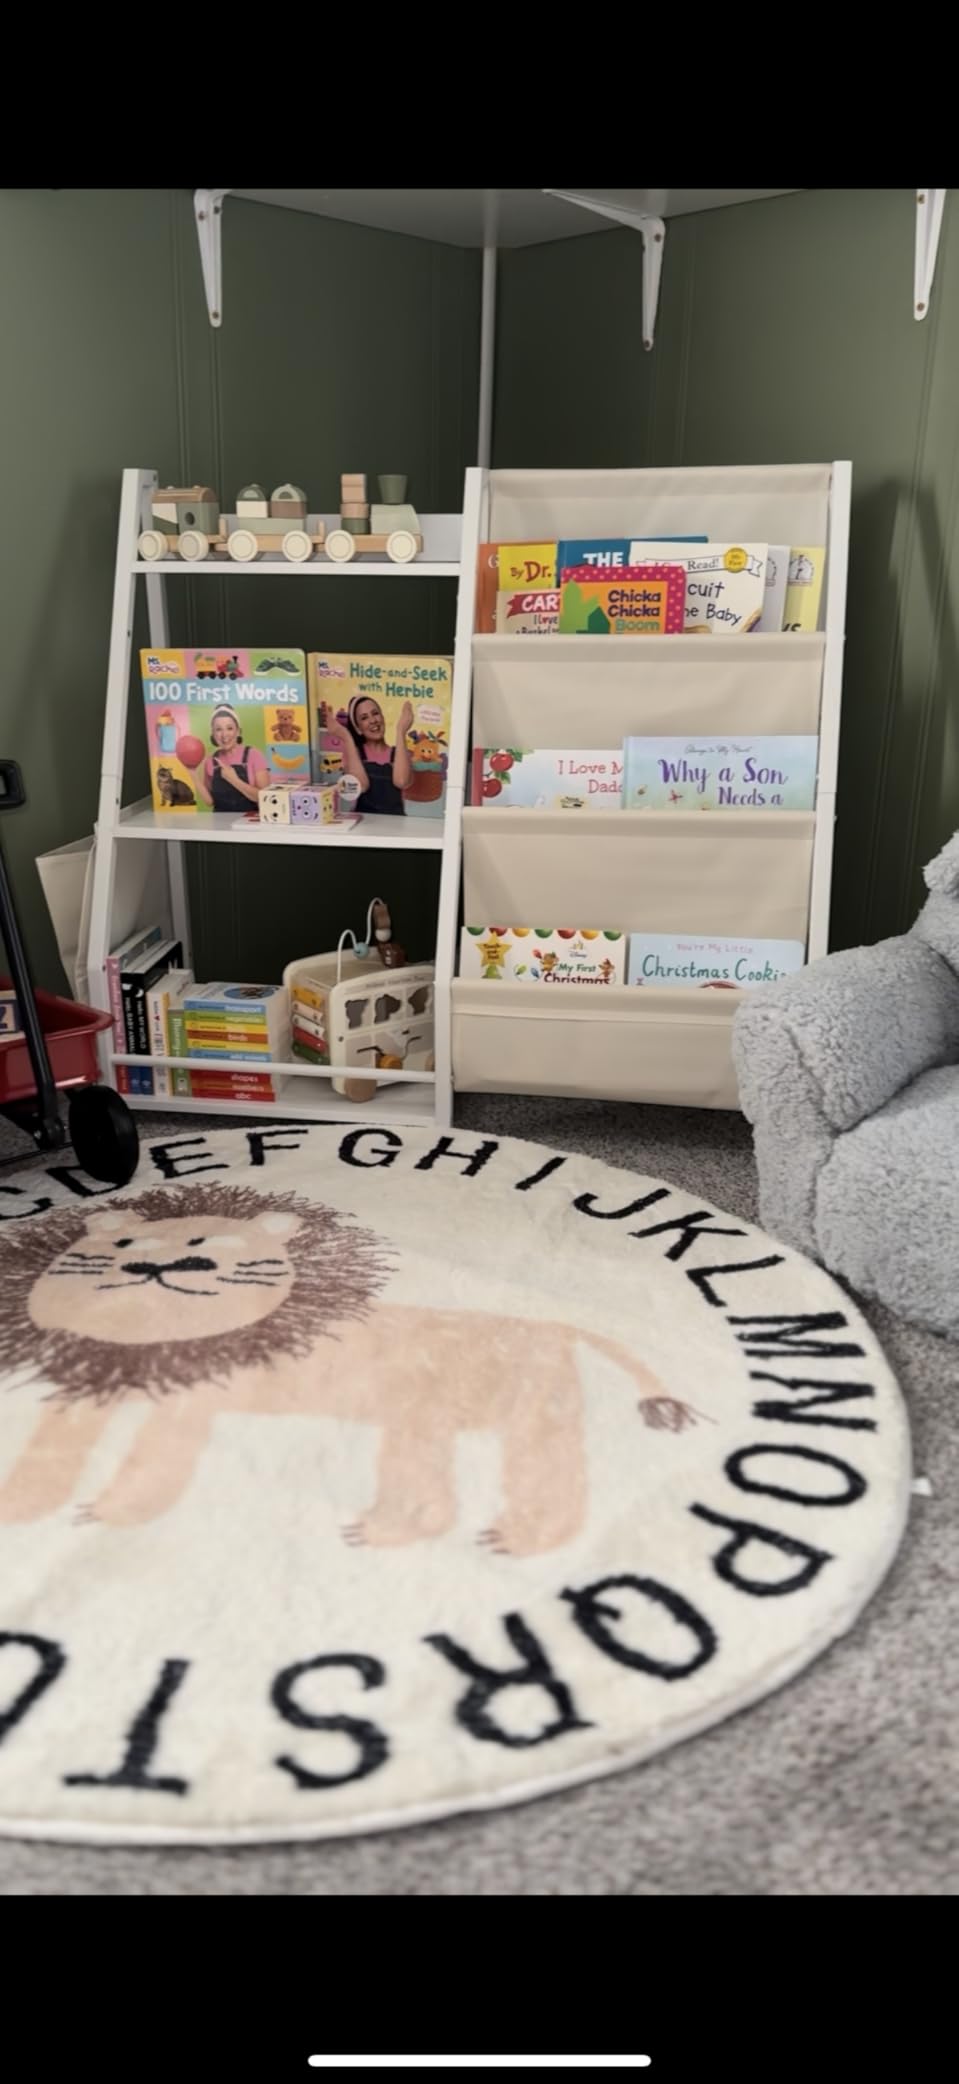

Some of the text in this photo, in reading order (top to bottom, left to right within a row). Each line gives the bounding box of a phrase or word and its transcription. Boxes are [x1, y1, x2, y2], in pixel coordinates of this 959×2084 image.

[510, 561, 552, 583] By Dr.
[582, 552, 624, 567] THE
[607, 604, 660, 617] Chicka
[608, 589, 661, 603] Chicka
[615, 619, 659, 631] Boom
[706, 603, 742, 626] Baby
[350, 662, 448, 681] Hide-and-Seek
[149, 682, 299, 702] 100 First Words
[359, 682, 434, 698] with Herbie
[558, 760, 564, 775] I
[569, 760, 606, 774] Love
[657, 757, 789, 794] Why a Son
[718, 786, 784, 806] Needs a
[708, 944, 721, 953] My
[558, 963, 596, 975] My First
[642, 953, 729, 979] Christmas
[149, 1137, 229, 1180] E
[246, 1129, 308, 1167] F
[339, 1129, 403, 1168] G
[414, 1136, 498, 1177] H
[515, 1157, 567, 1190] I
[572, 1188, 671, 1219] J
[628, 1211, 748, 1262] K
[685, 1255, 785, 1308] L
[726, 1311, 866, 1359] M
[749, 1371, 877, 1432] N
[724, 1444, 867, 1507] O
[690, 1503, 834, 1598] P
[559, 1575, 717, 1681] Q
[422, 1614, 594, 1748] R
[63, 1660, 189, 1796] T
[271, 1654, 389, 1789] S
